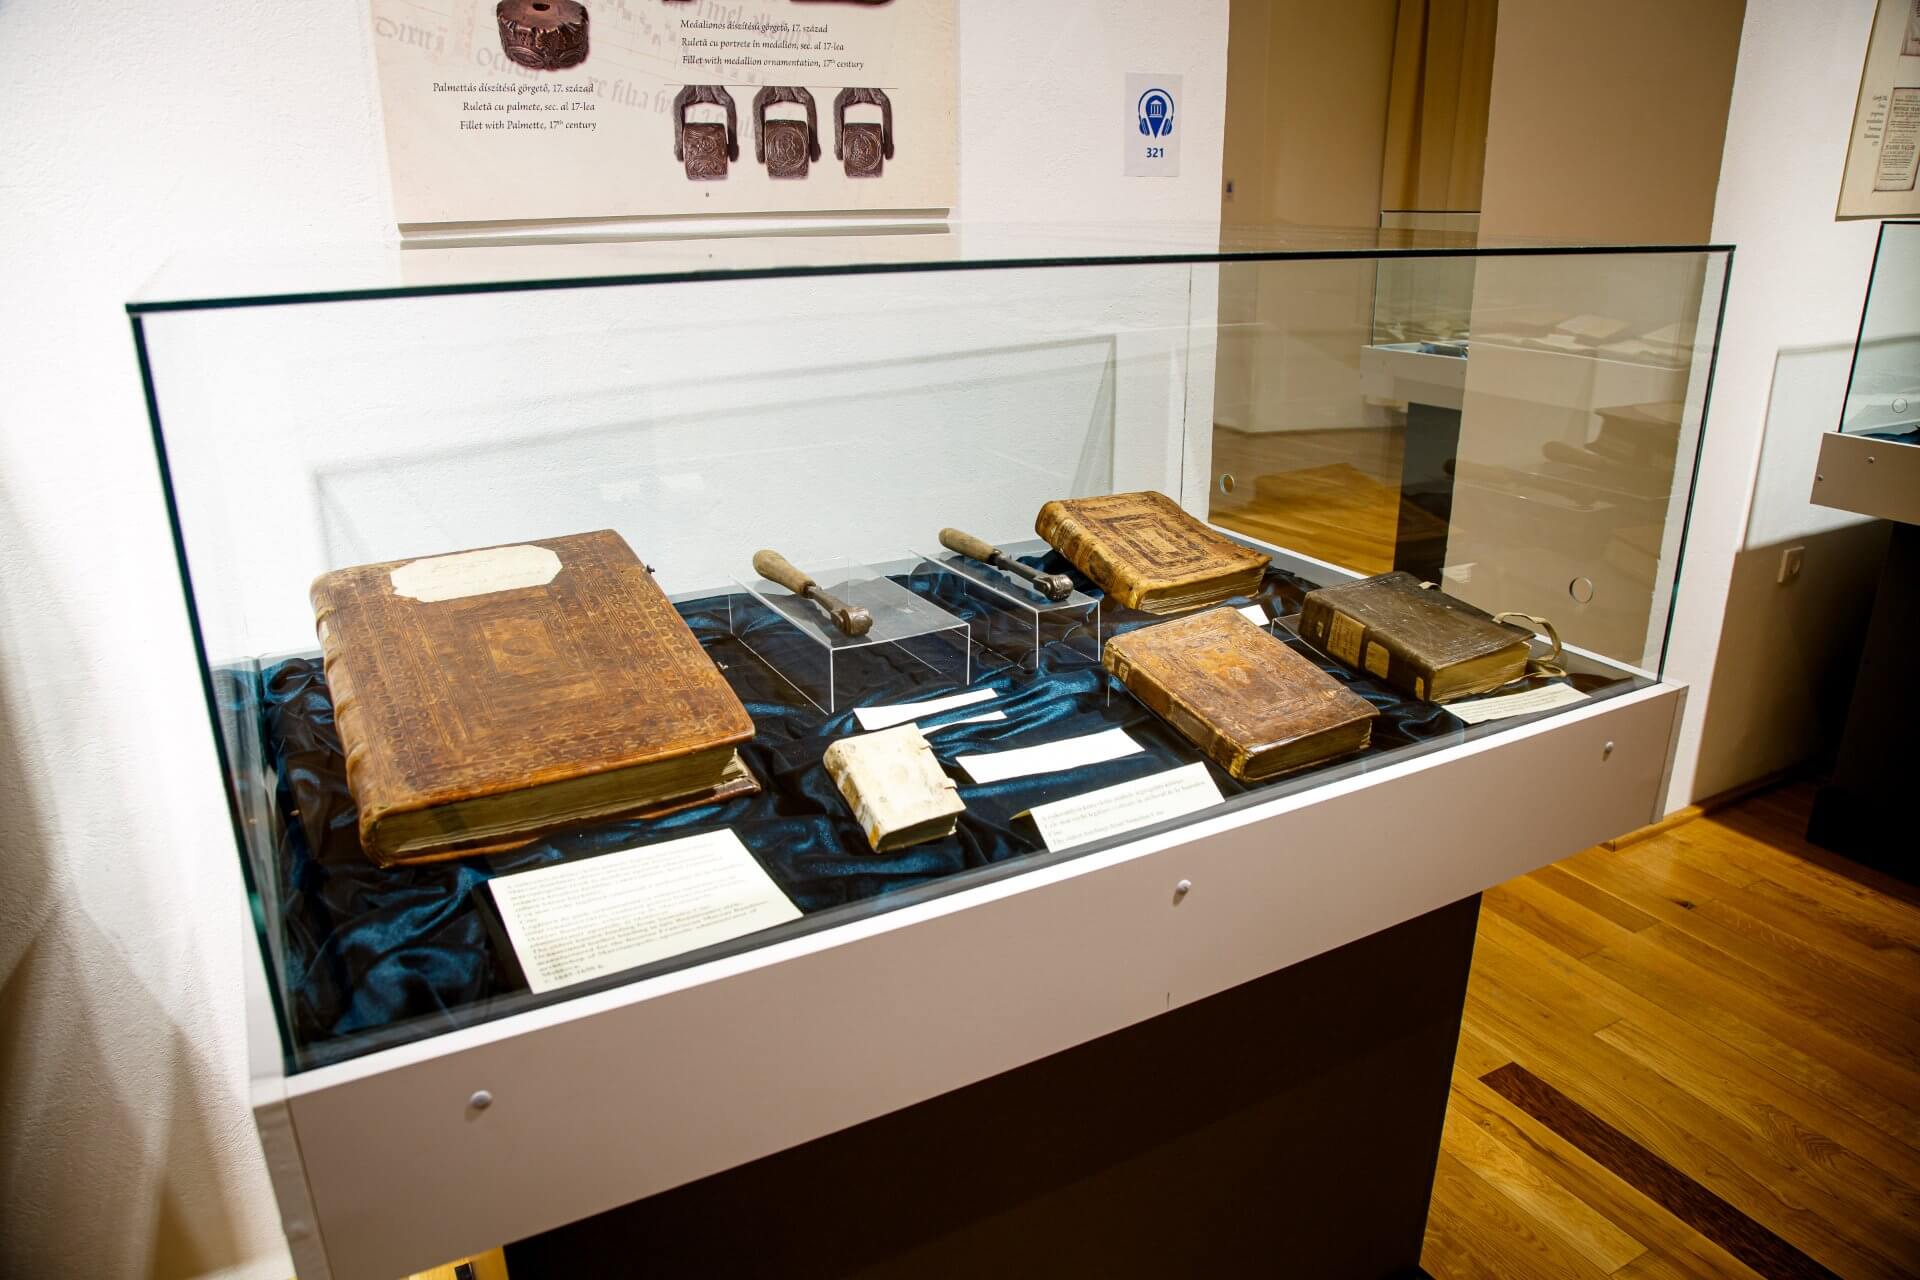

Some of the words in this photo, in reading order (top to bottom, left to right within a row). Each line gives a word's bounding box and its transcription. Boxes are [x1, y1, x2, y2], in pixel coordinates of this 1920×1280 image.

[720, 40, 751, 50] portrete
[762, 40, 799, 50] medalion,
[814, 42, 821, 50] al
[823, 42, 844, 51] 17-lea
[682, 55, 703, 64] Fillet
[704, 56, 722, 64] with
[724, 56, 761, 65] medallion
[763, 58, 821, 67] ornamentation,
[836, 60, 864, 71] century
[552, 84, 564, 93] 17.
[565, 83, 594, 93] század
[506, 101, 543, 114] palmete,
[560, 101, 569, 111] al
[571, 102, 595, 111] 17-lea
[460, 120, 483, 130] Fillet
[484, 120, 505, 130] with
[506, 120, 547, 132] Palmette,
[565, 121, 597, 132] century
[1146, 147, 1164, 158] 321
